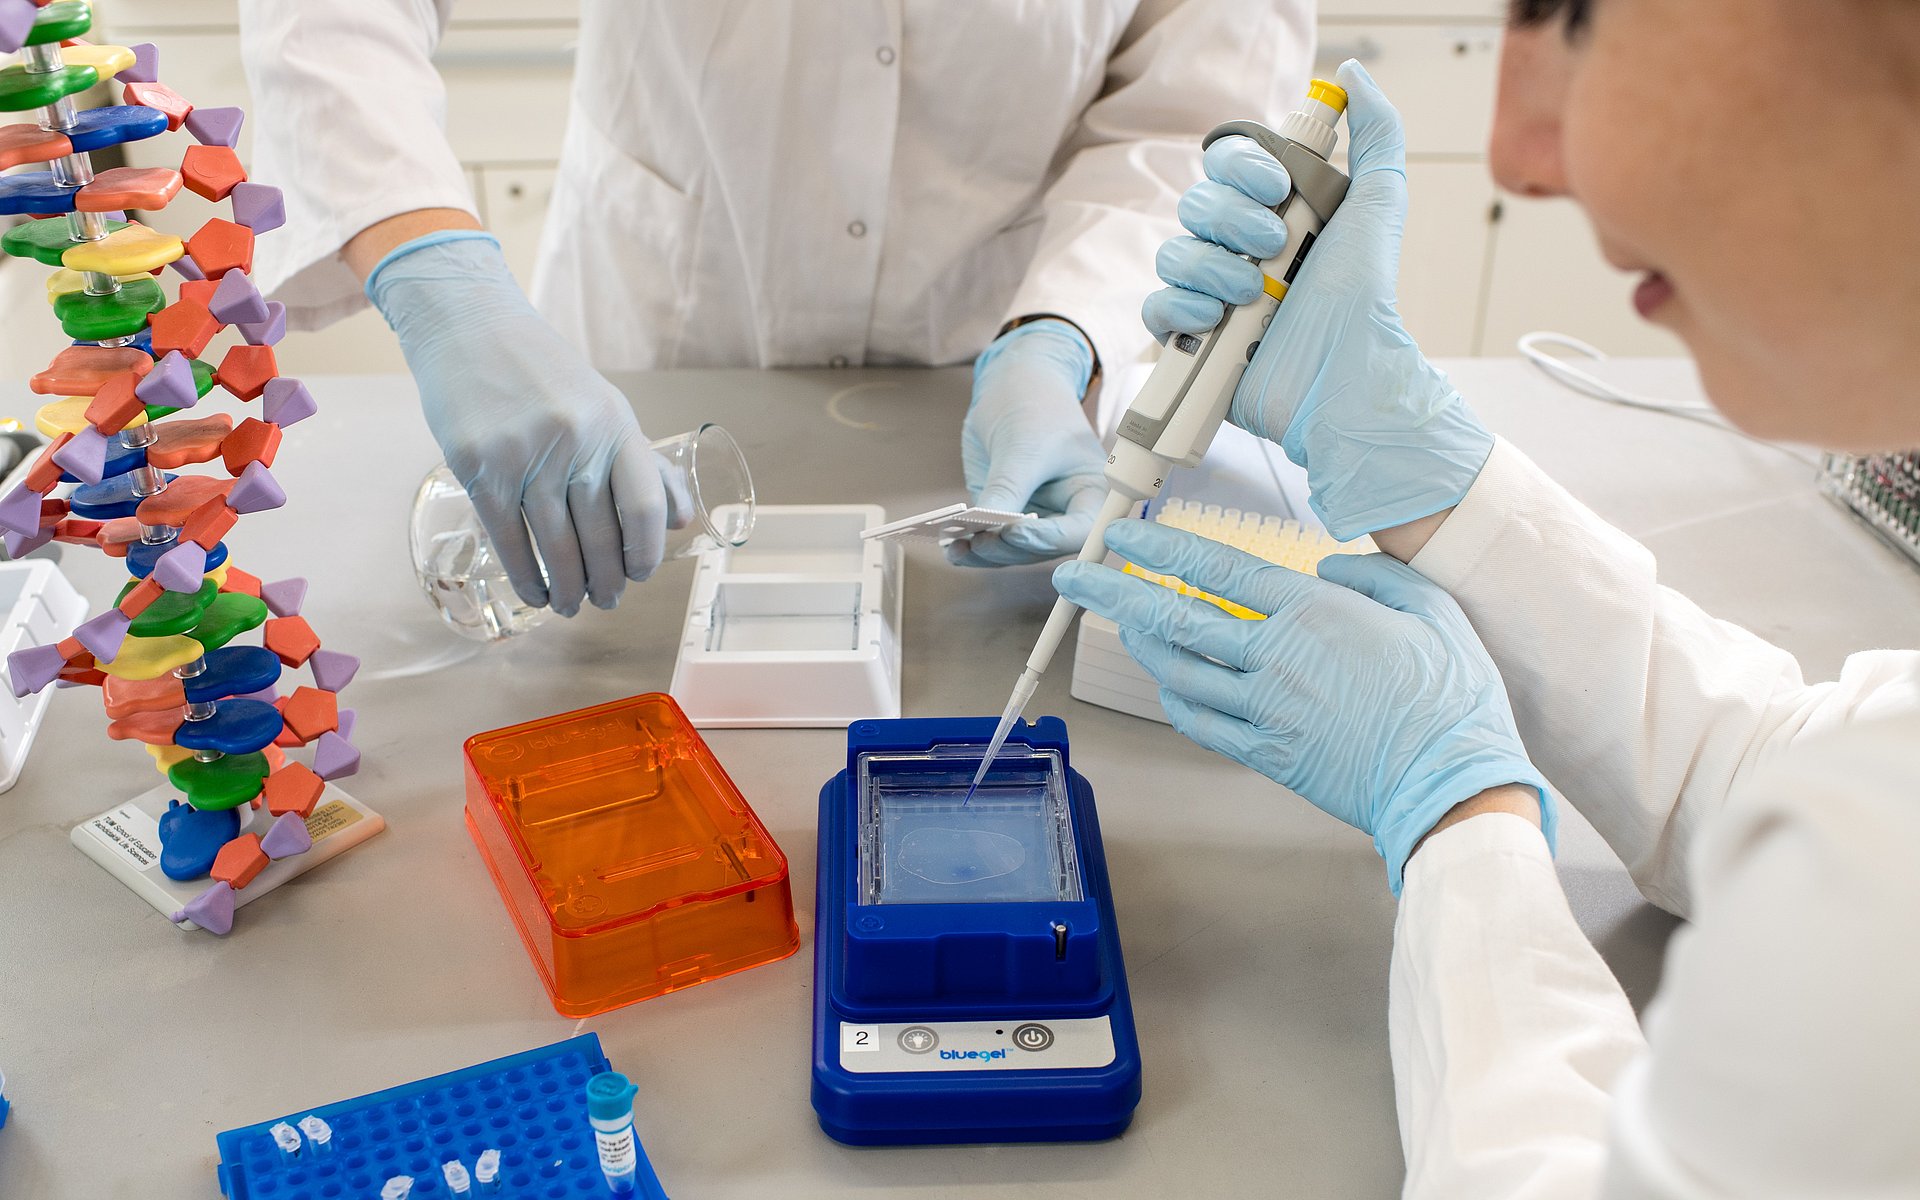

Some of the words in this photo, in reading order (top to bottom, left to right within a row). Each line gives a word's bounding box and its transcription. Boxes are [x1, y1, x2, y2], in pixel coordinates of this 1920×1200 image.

[1153, 477, 1164, 489] 20
[103, 816, 117, 826] TUM
[113, 825, 131, 839] School
[133, 840, 157, 860] Education
[118, 840, 130, 849] Life
[127, 847, 150, 866] Sciences
[856, 1031, 869, 1045] 2
